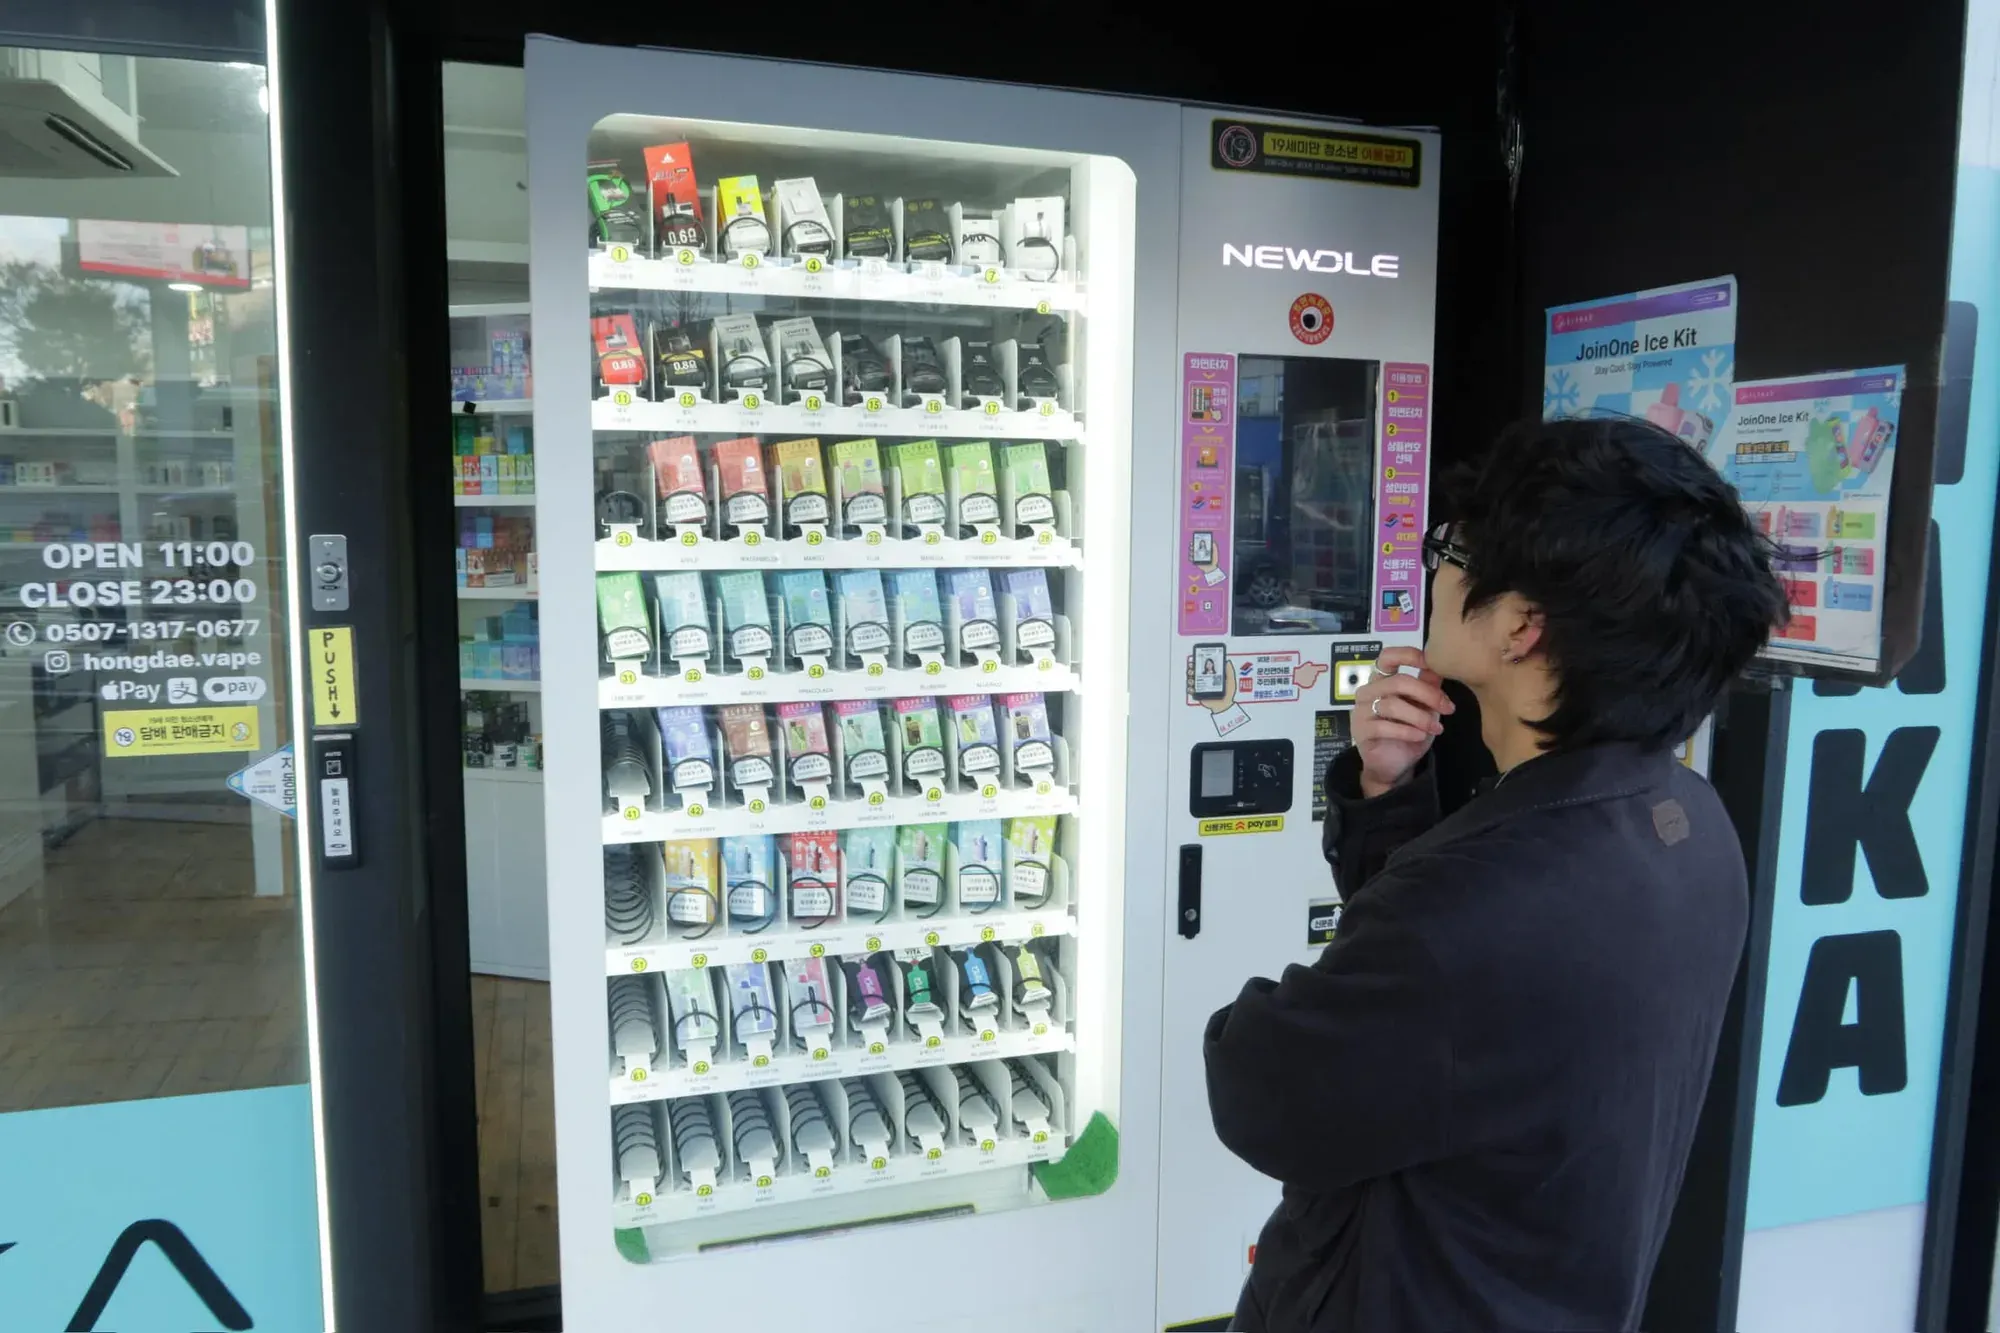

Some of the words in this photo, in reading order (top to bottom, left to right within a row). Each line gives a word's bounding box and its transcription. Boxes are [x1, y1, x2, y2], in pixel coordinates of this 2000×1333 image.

[1271, 137, 1320, 155] 19세미만
[1324, 143, 1359, 160] 청소년
[1223, 243, 1399, 278] NEWDLE
[1576, 338, 1639, 361] JoinOne
[1644, 334, 1669, 352] Ice
[1673, 327, 1697, 347] Kit
[612, 359, 636, 371] 0.8Ω
[673, 360, 698, 371] 0.8Ω
[1737, 414, 1777, 426] JoinOne
[1778, 413, 1793, 423] Ice
[1795, 411, 1809, 422] Kit
[43, 543, 143, 568] OPEN
[159, 542, 255, 567] 11:00
[19, 581, 143, 608] CLOSE
[151, 579, 257, 604] 23:00
[46, 620, 260, 642] 0507-1317-0677
[84, 651, 262, 674] hongdae.vape
[323, 632, 338, 701] PUSH
[121, 681, 161, 703] Pay
[228, 680, 257, 694] pay
[140, 725, 167, 741] 담배
[172, 723, 225, 739] 판매금지
[1204, 823, 1233, 832] 신용카드
[1247, 820, 1263, 829] pay
